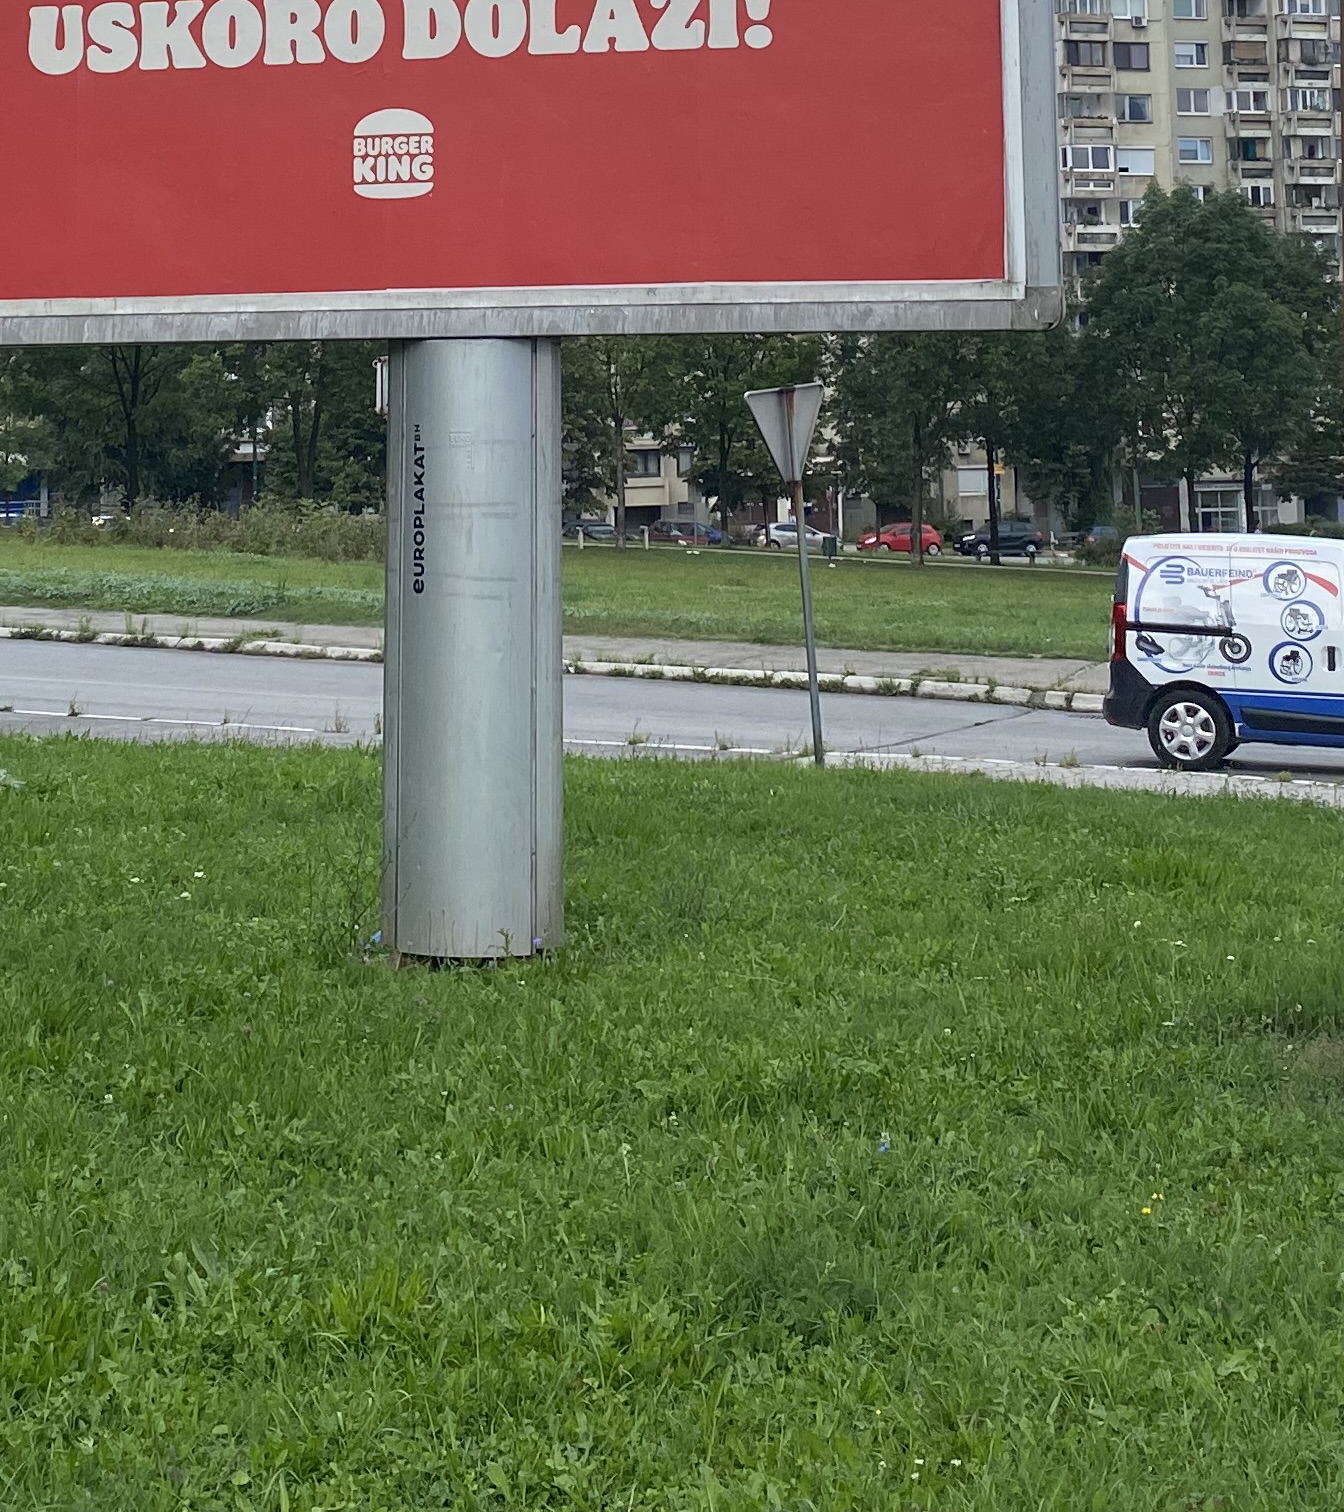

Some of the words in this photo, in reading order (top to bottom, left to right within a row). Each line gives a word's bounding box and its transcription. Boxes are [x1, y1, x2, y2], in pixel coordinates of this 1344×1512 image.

[353, 135, 434, 156] BURGER
[353, 154, 434, 183] KING
[1187, 567, 1253, 579] BAUERFEIND
